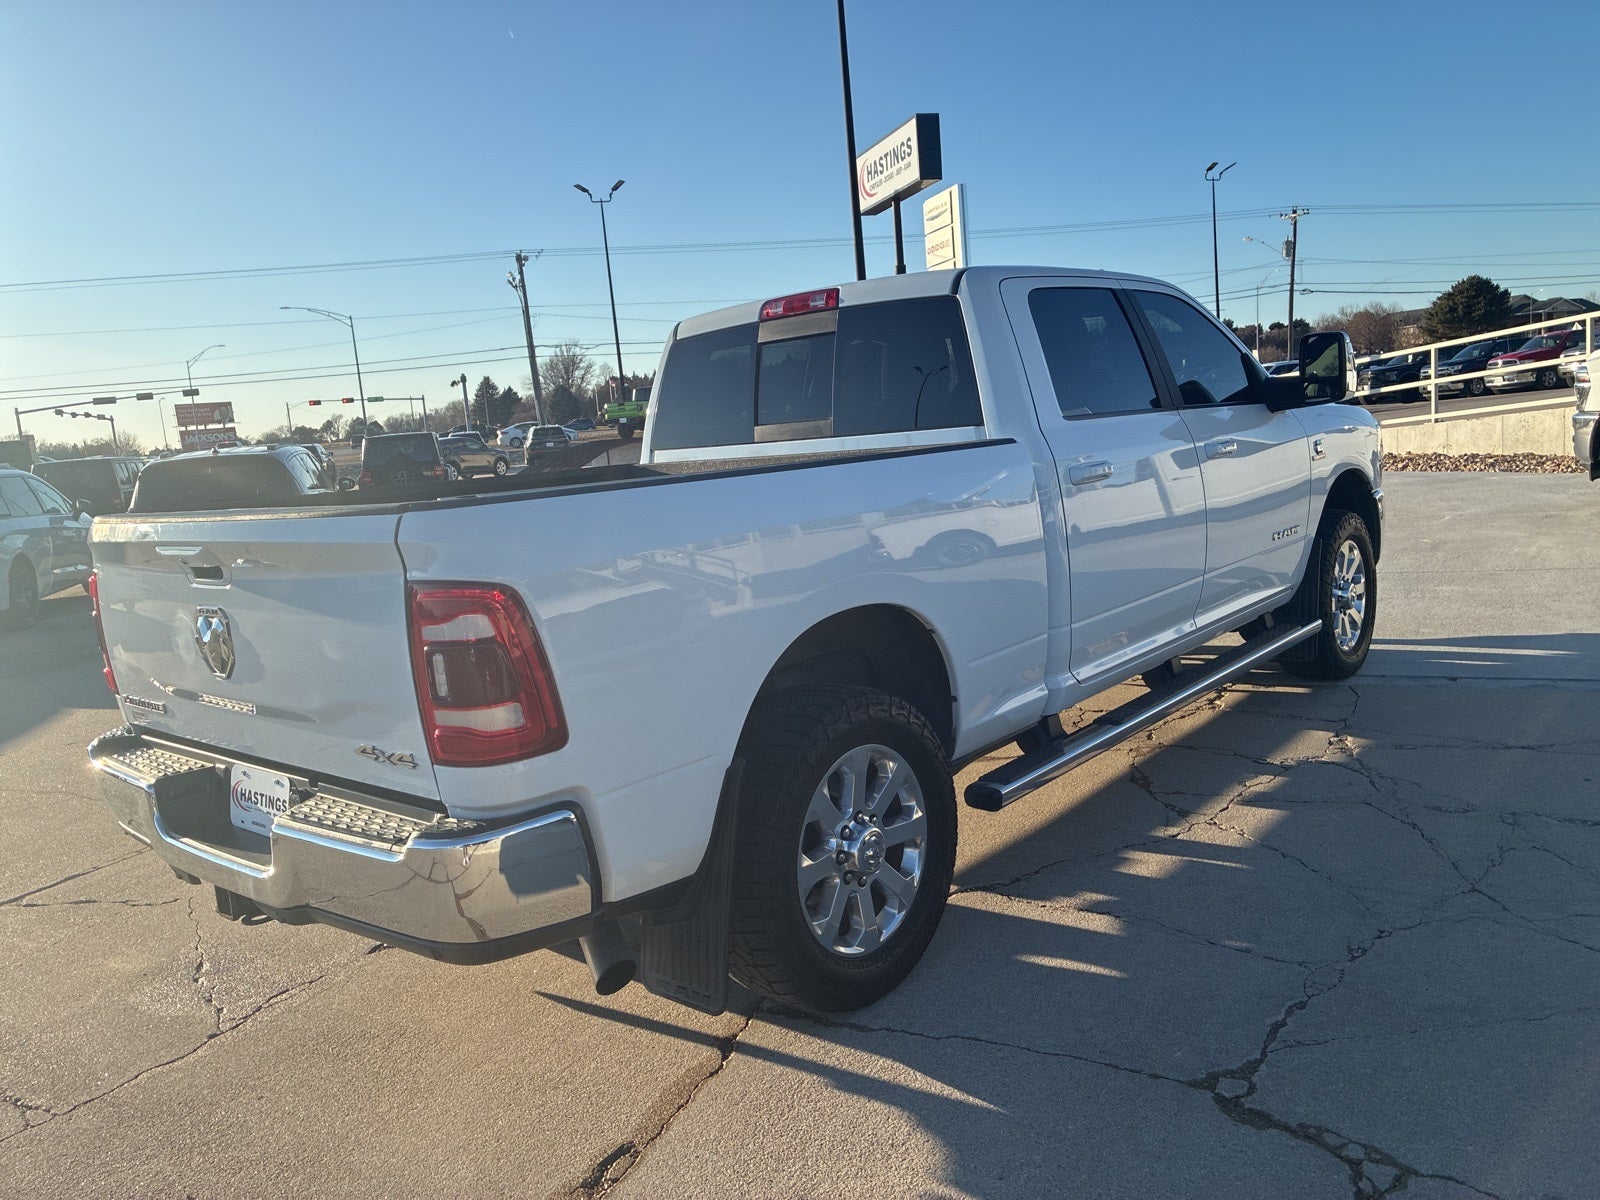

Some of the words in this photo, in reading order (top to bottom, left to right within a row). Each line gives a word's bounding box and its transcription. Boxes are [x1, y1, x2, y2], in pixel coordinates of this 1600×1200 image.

[866, 136, 913, 183] HASTINGS
[927, 239, 951, 255] DODGE
[1272, 524, 1300, 541] RAM
[198, 608, 219, 616] RAM
[240, 787, 288, 813] HASTINGS
